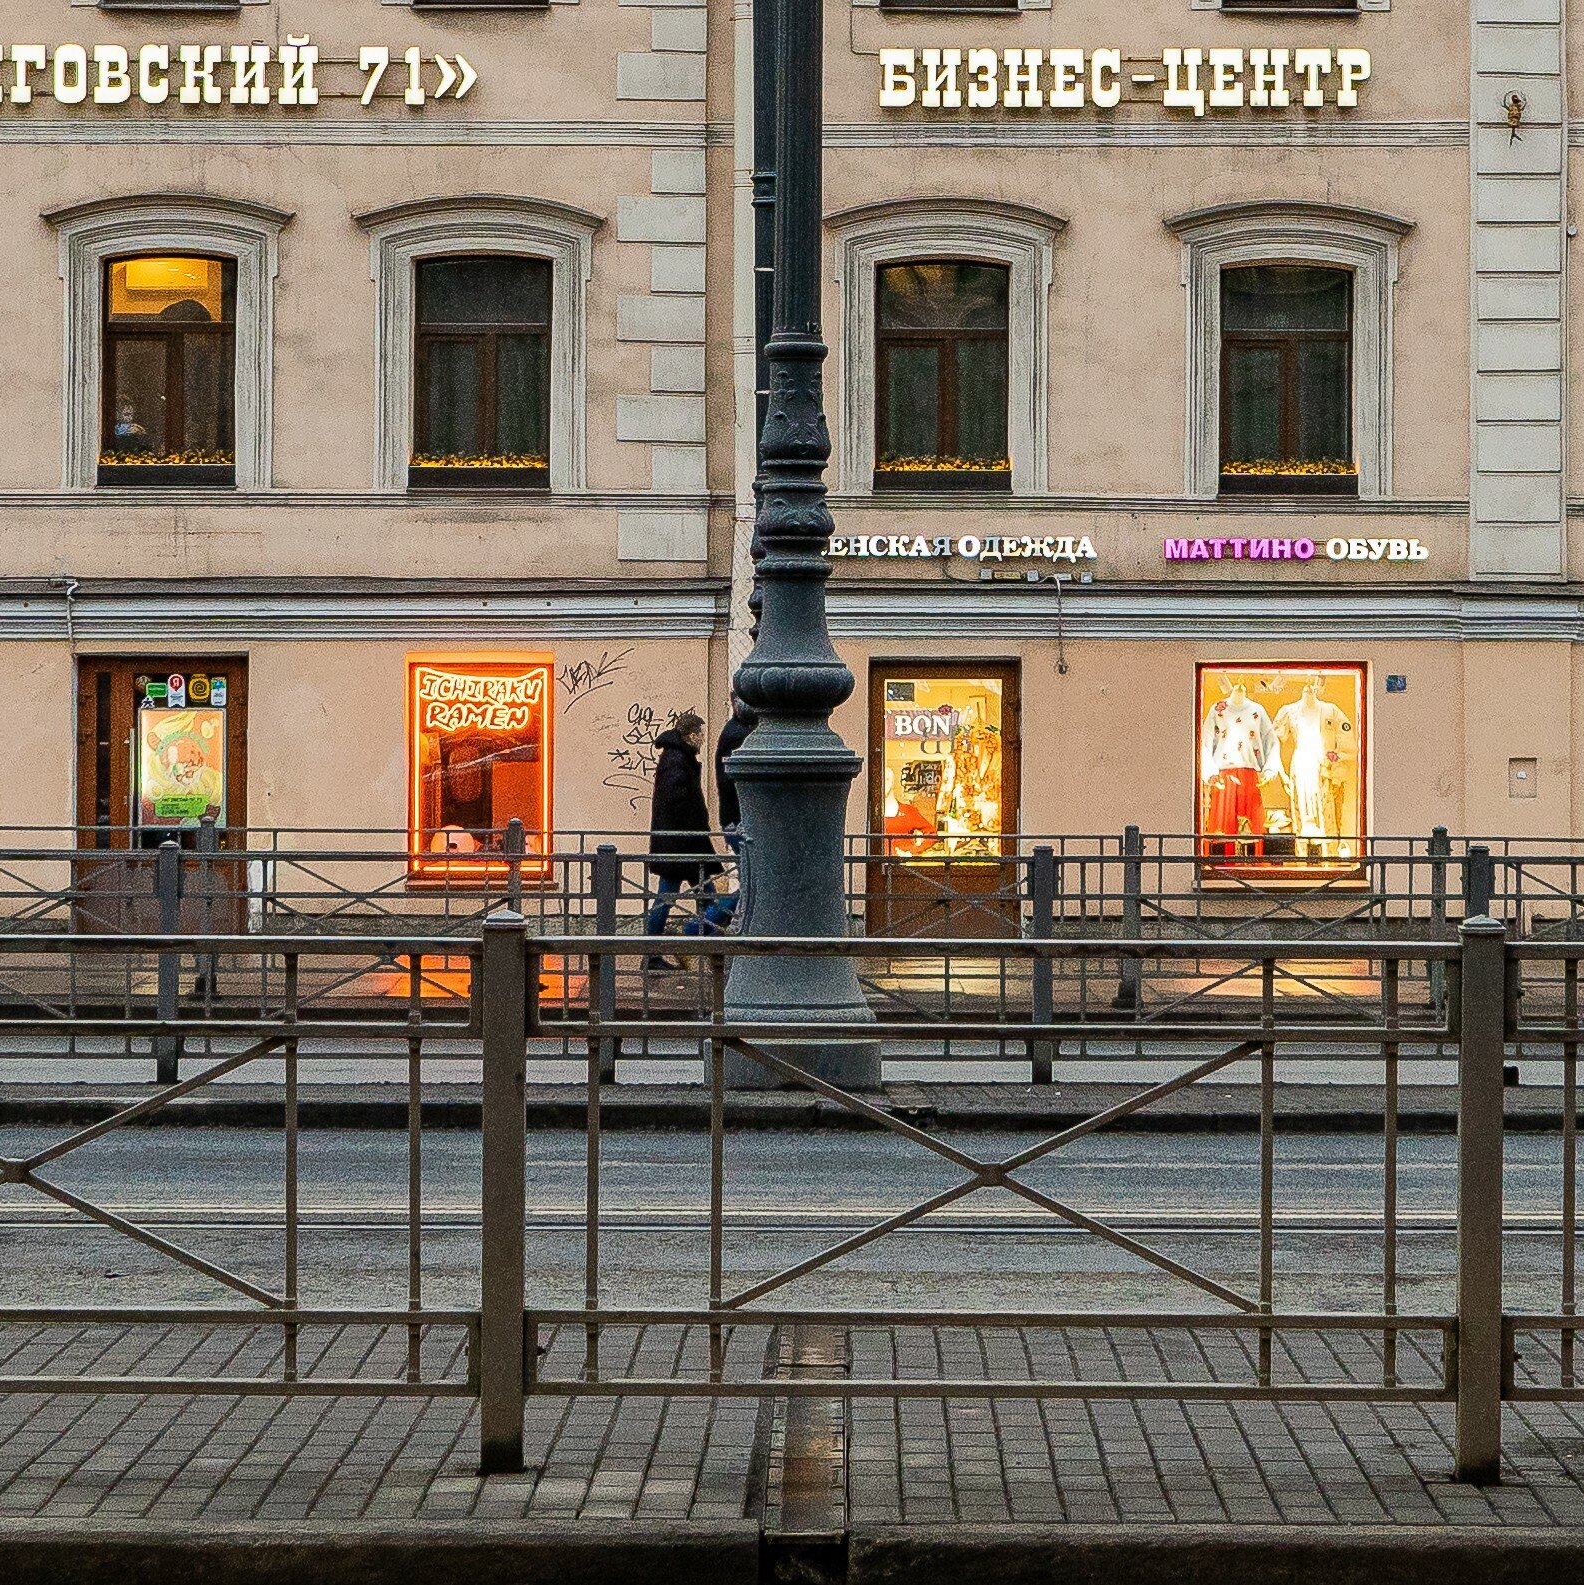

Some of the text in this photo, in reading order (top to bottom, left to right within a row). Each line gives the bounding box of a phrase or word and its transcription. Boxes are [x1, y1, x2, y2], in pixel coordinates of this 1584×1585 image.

[360, 45, 479, 106] 71»
[878, 47, 1372, 117] БИЗНЕС-ЦЕНТР
[820, 534, 1097, 563] ЕНСКАЯ ОДЕЖДА
[1164, 537, 1430, 561] МАТТИНО ОБУВЬ
[426, 702, 529, 731] RAMEN
[894, 714, 952, 736] BON
